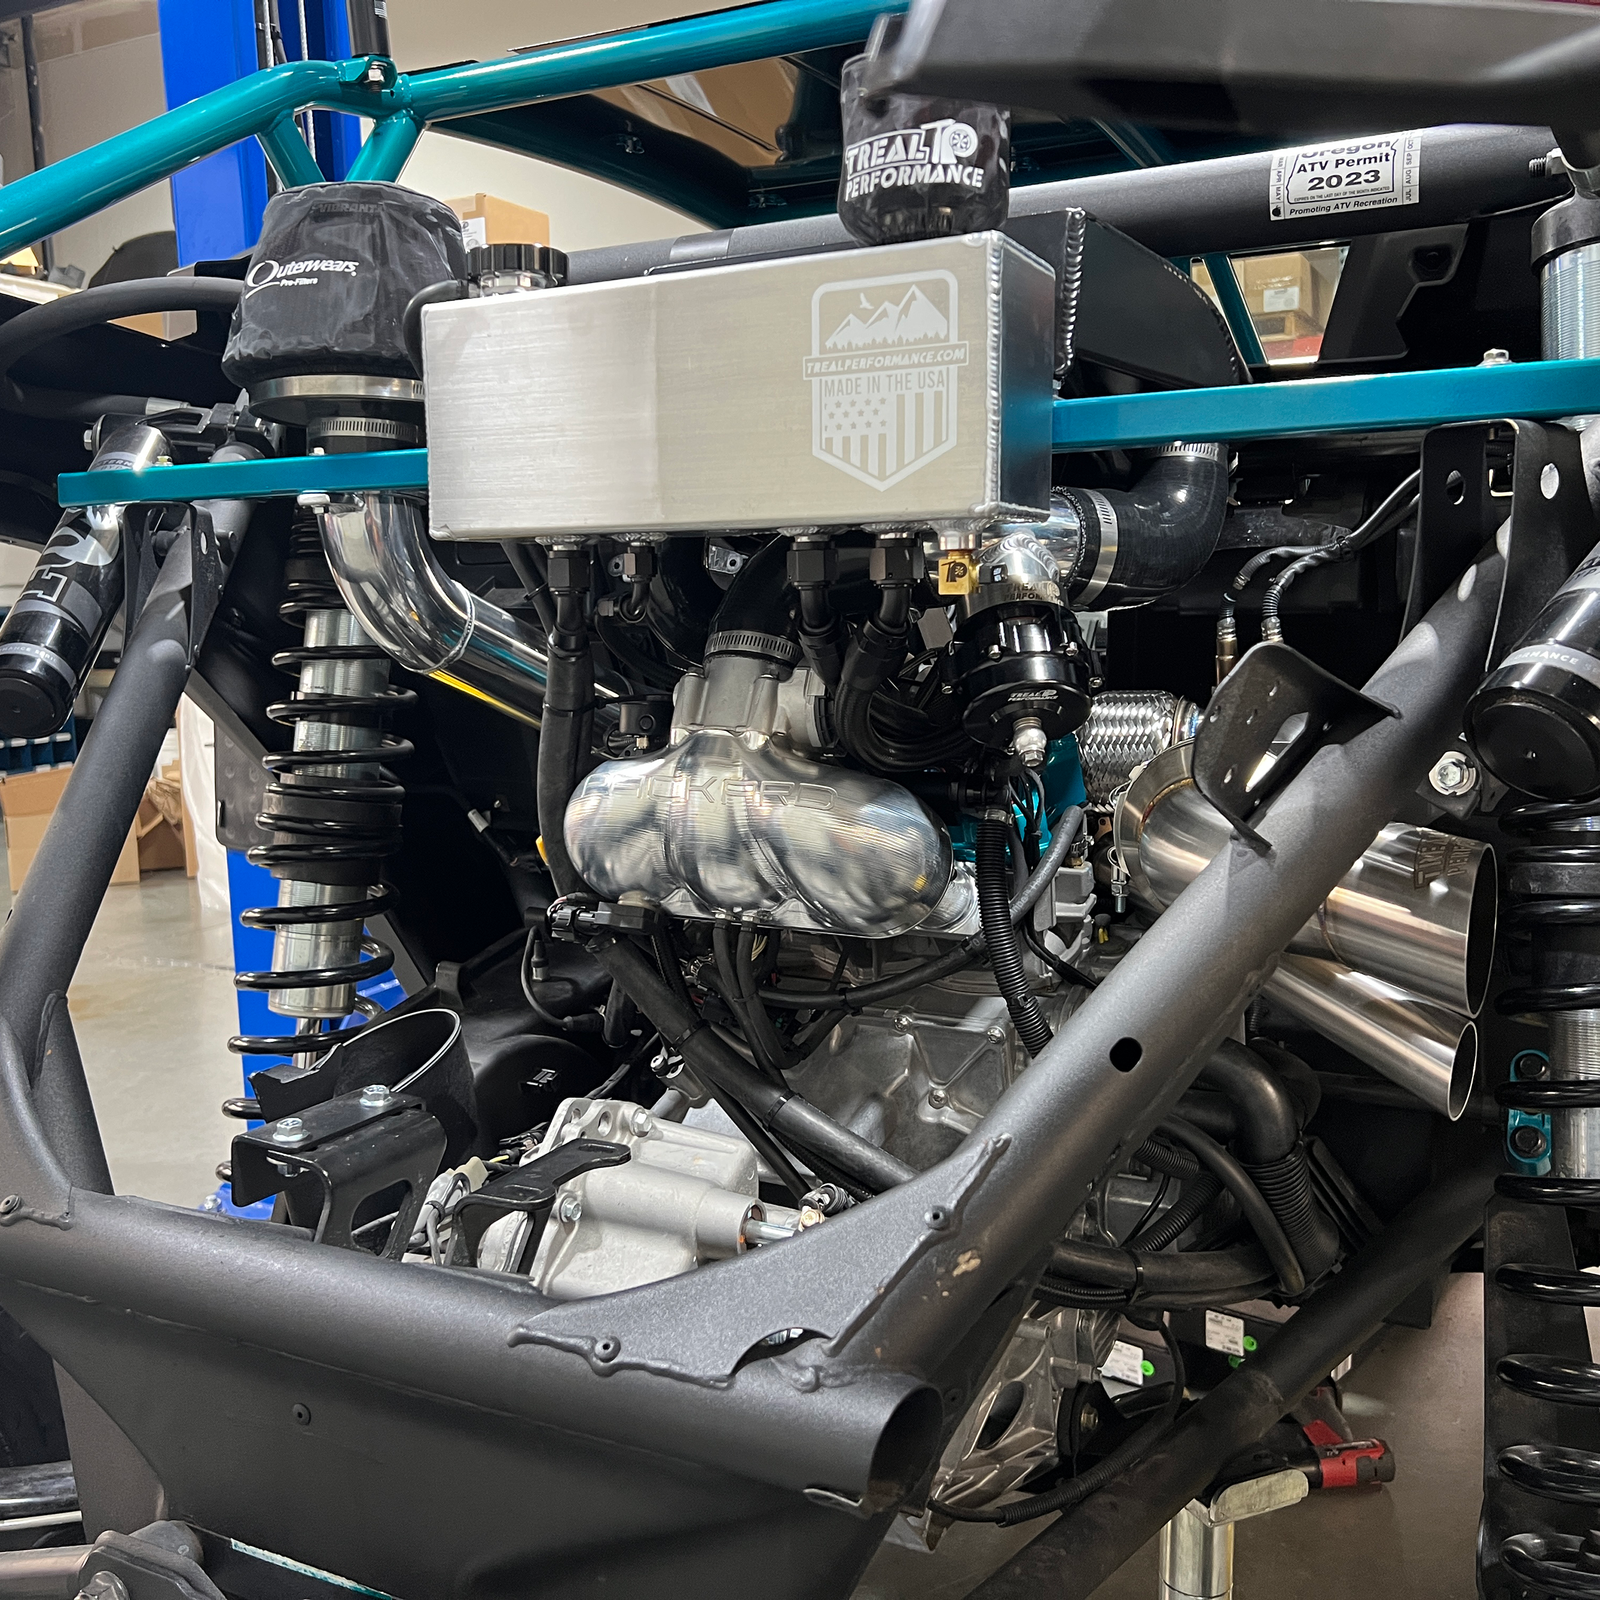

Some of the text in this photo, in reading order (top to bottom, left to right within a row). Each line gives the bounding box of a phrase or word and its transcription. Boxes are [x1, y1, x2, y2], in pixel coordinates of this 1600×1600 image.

[847, 133, 925, 175] TREAL
[1296, 152, 1391, 174] ATV Permit
[845, 164, 985, 201] PERFORMANCE
[1308, 169, 1380, 191] 2023
[1289, 204, 1331, 215] Promoting
[1333, 201, 1352, 210] ATV
[1353, 197, 1398, 208] Recreation
[246, 260, 359, 288] Outerwears
[806, 348, 965, 374] TREALPERFORMANCE.COM
[824, 370, 945, 398] MADE IN THE USA
